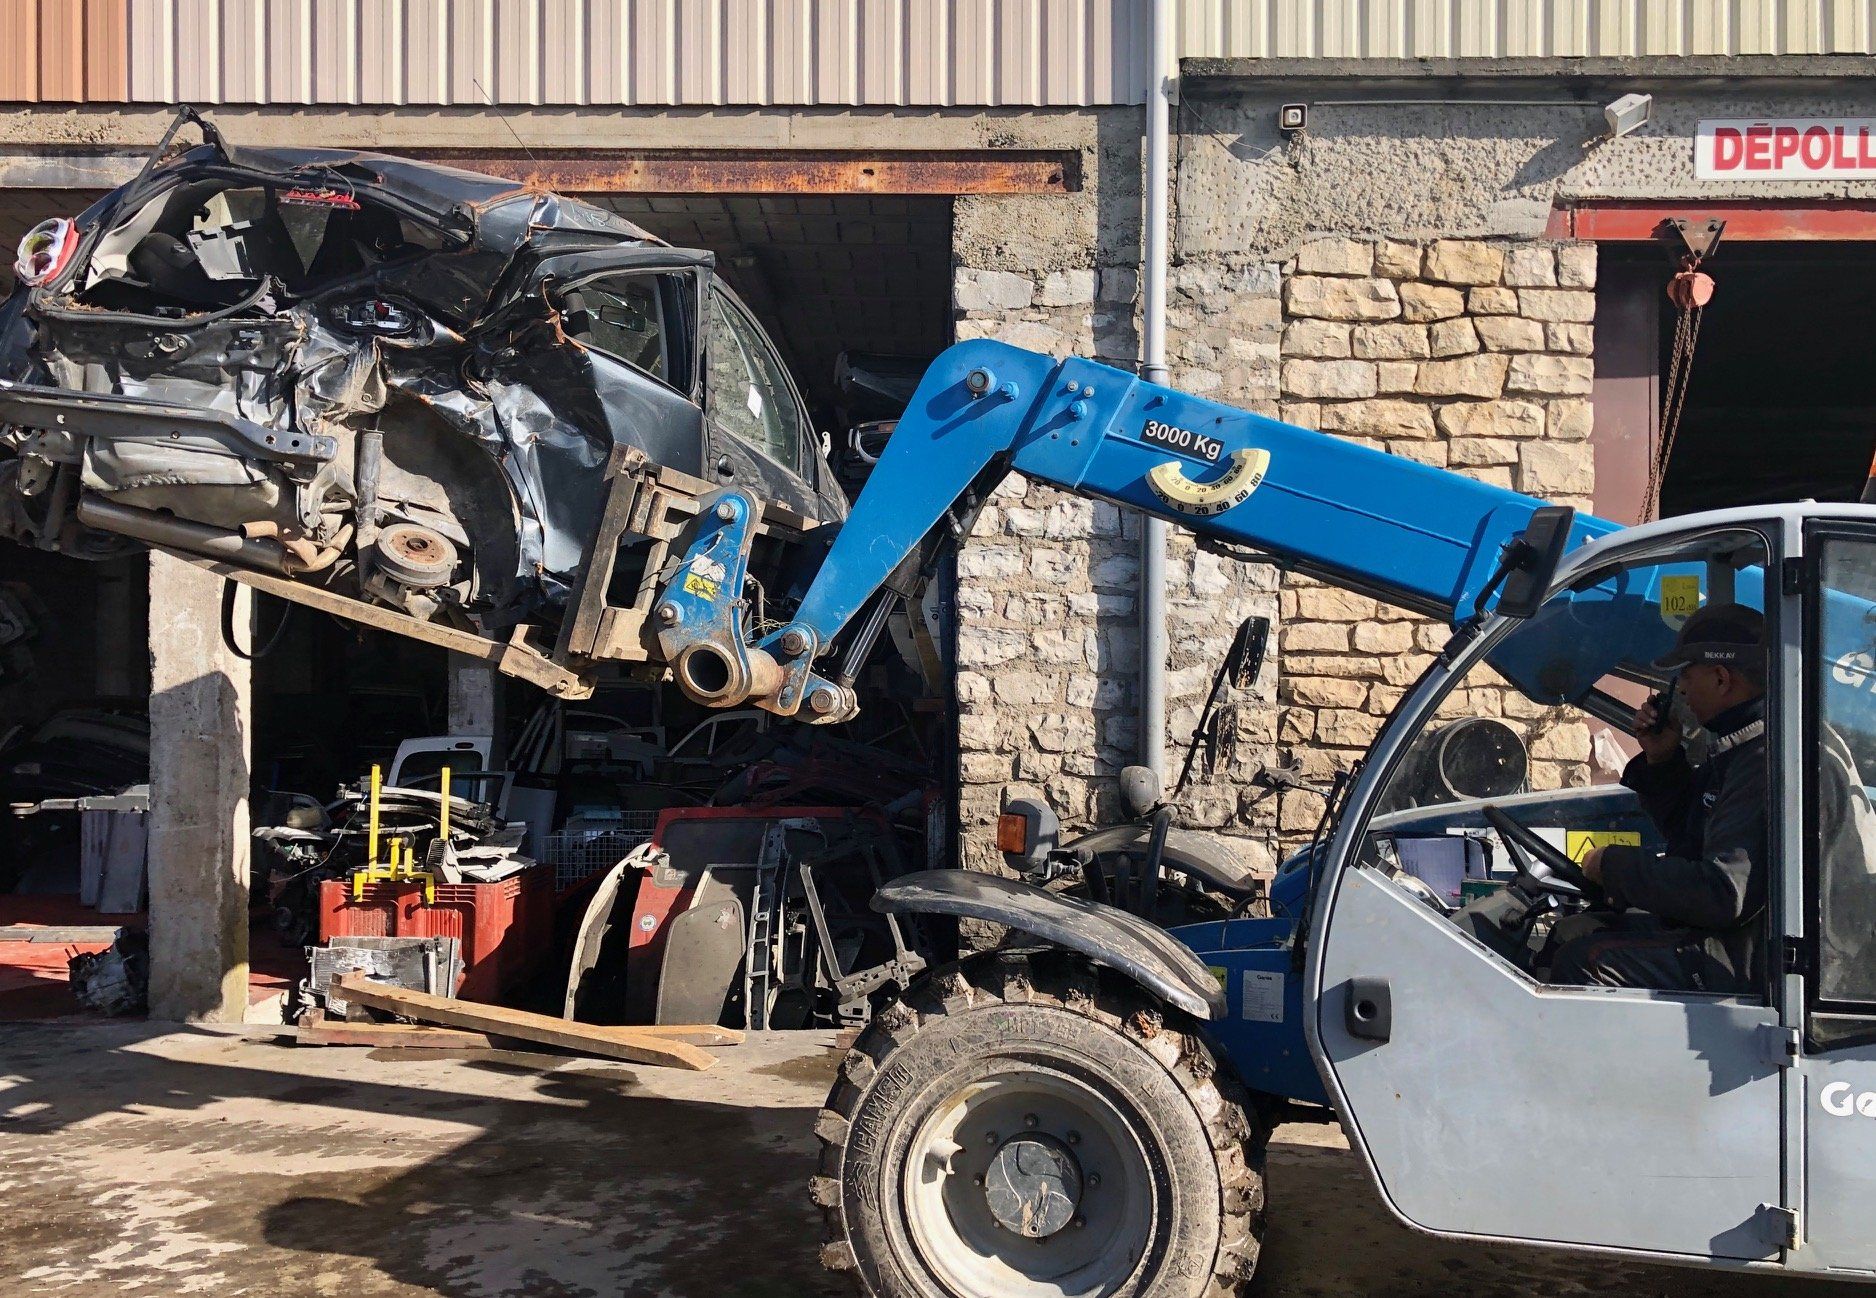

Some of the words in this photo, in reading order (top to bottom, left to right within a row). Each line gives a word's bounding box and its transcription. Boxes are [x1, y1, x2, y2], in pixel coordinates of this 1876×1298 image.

[1145, 420, 1192, 447] 3000
[1193, 434, 1221, 460] Kg
[1177, 503, 1185, 512] 0
[1194, 506, 1209, 515] 20
[1216, 501, 1231, 512] 40
[1234, 489, 1249, 503] 60
[1250, 472, 1262, 487] 80
[1210, 483, 1221, 491] 40
[1223, 475, 1234, 485] 60
[1665, 594, 1686, 611] 102
